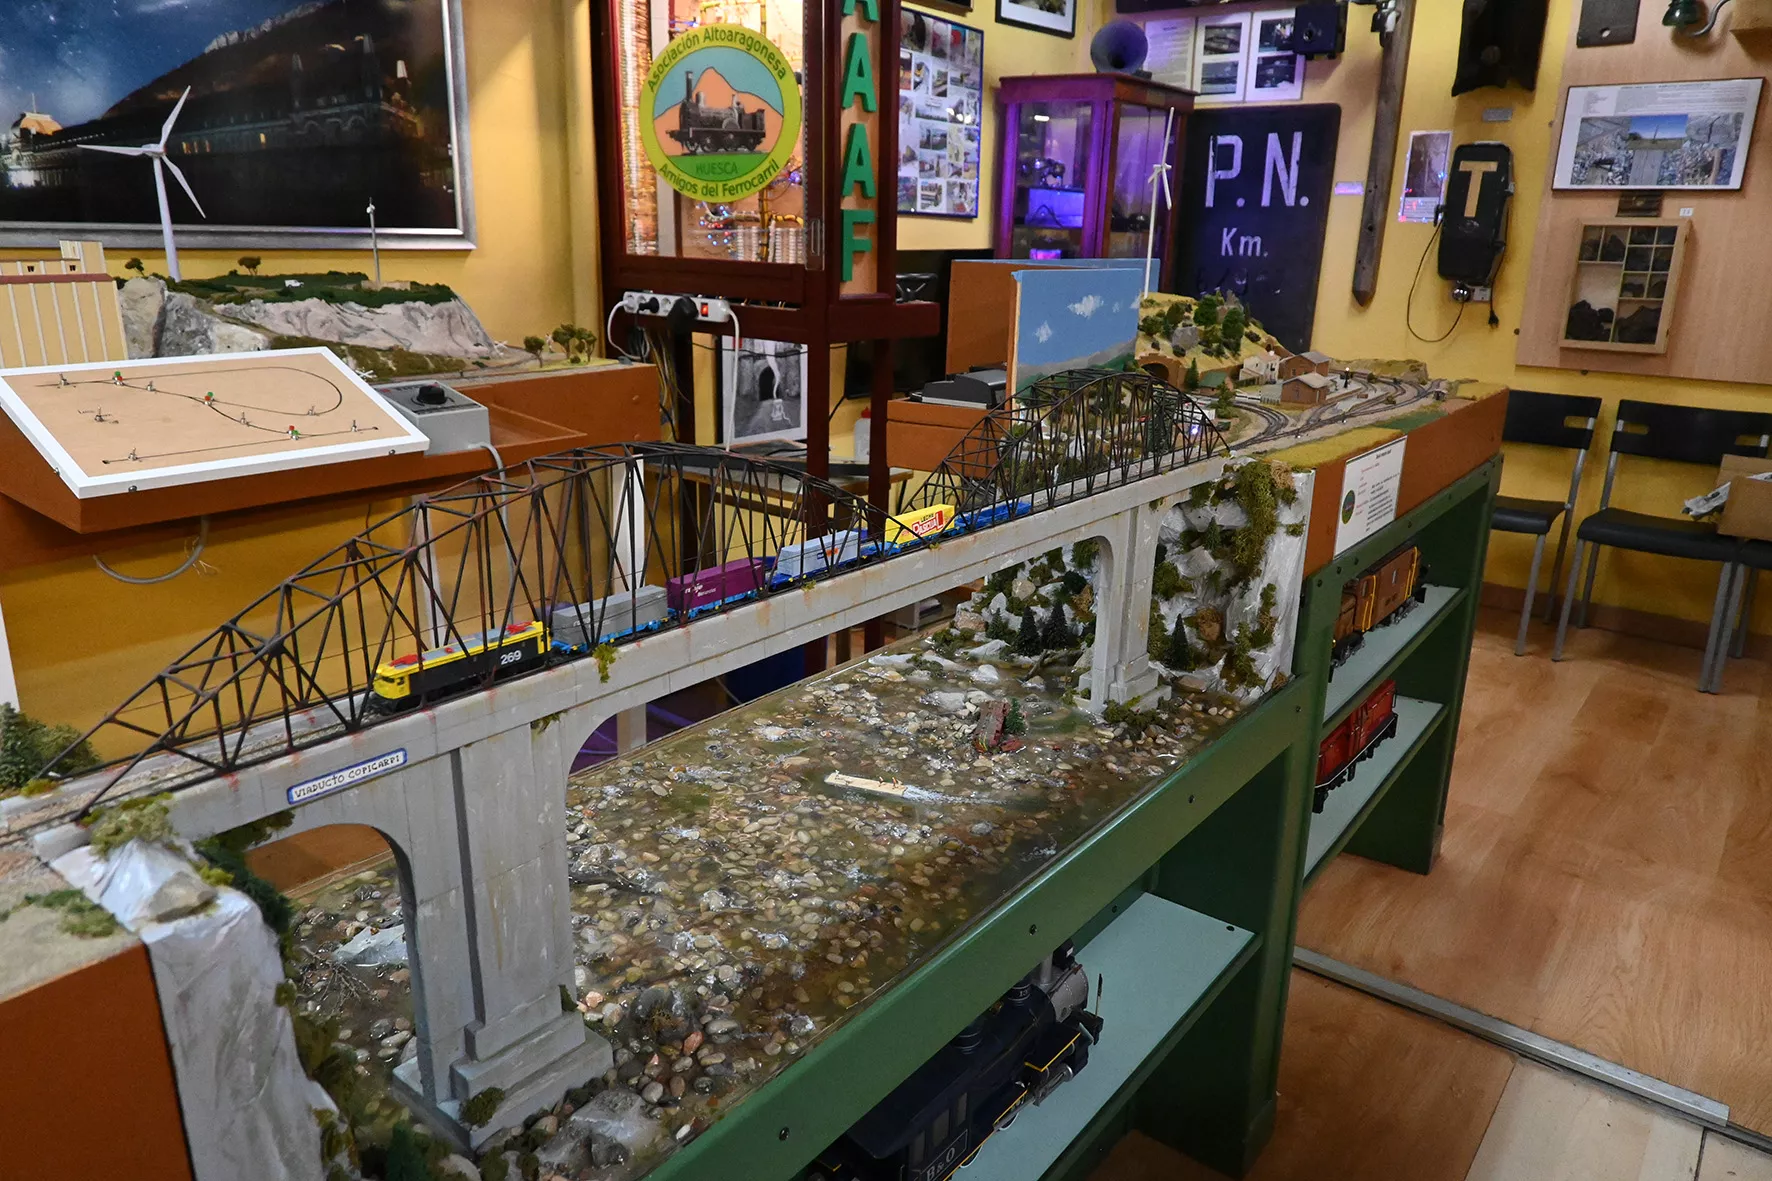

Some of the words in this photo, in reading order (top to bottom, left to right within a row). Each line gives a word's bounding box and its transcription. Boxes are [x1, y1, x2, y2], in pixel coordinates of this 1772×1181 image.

[648, 33, 700, 93] Asociación
[703, 27, 787, 80] Altoaragonesa
[842, 0, 879, 282] AAF
[659, 163, 698, 193] Amigos
[701, 185, 719, 196] del
[722, 158, 780, 197] Ferrocarril
[695, 161, 739, 175] HUESCA
[1204, 131, 1310, 208] P.N.
[1458, 160, 1499, 218] T
[1221, 228, 1269, 258] Km.
[500, 650, 522, 665] 269
[294, 774, 345, 798] VIADUCTO
